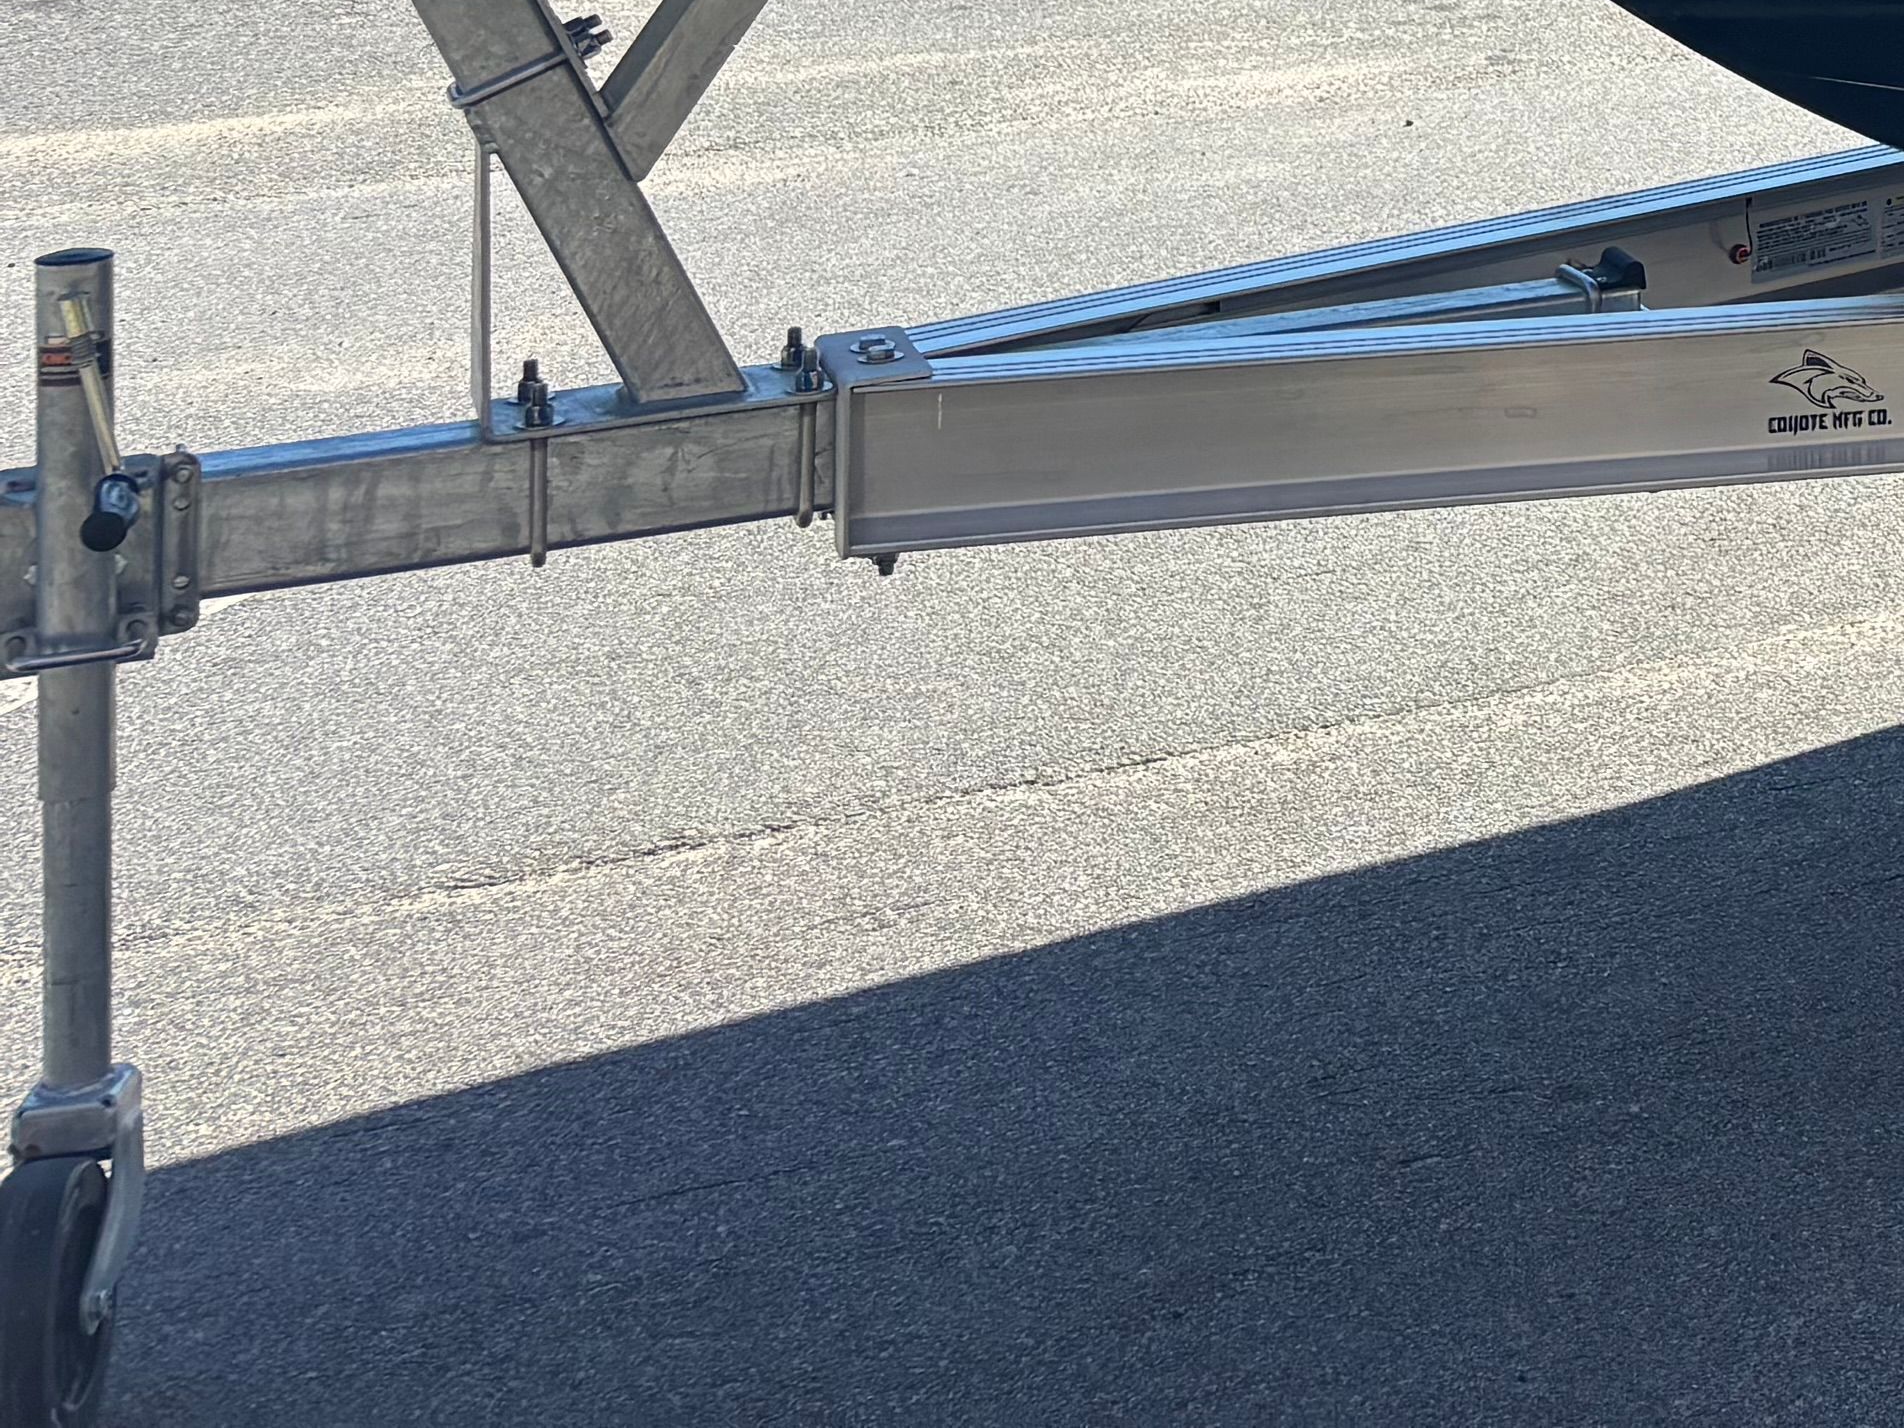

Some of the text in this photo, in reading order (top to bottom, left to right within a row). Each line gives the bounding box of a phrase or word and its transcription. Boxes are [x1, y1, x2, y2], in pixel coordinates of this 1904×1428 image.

[1768, 409, 1892, 435] COYOTE MFG CO.
